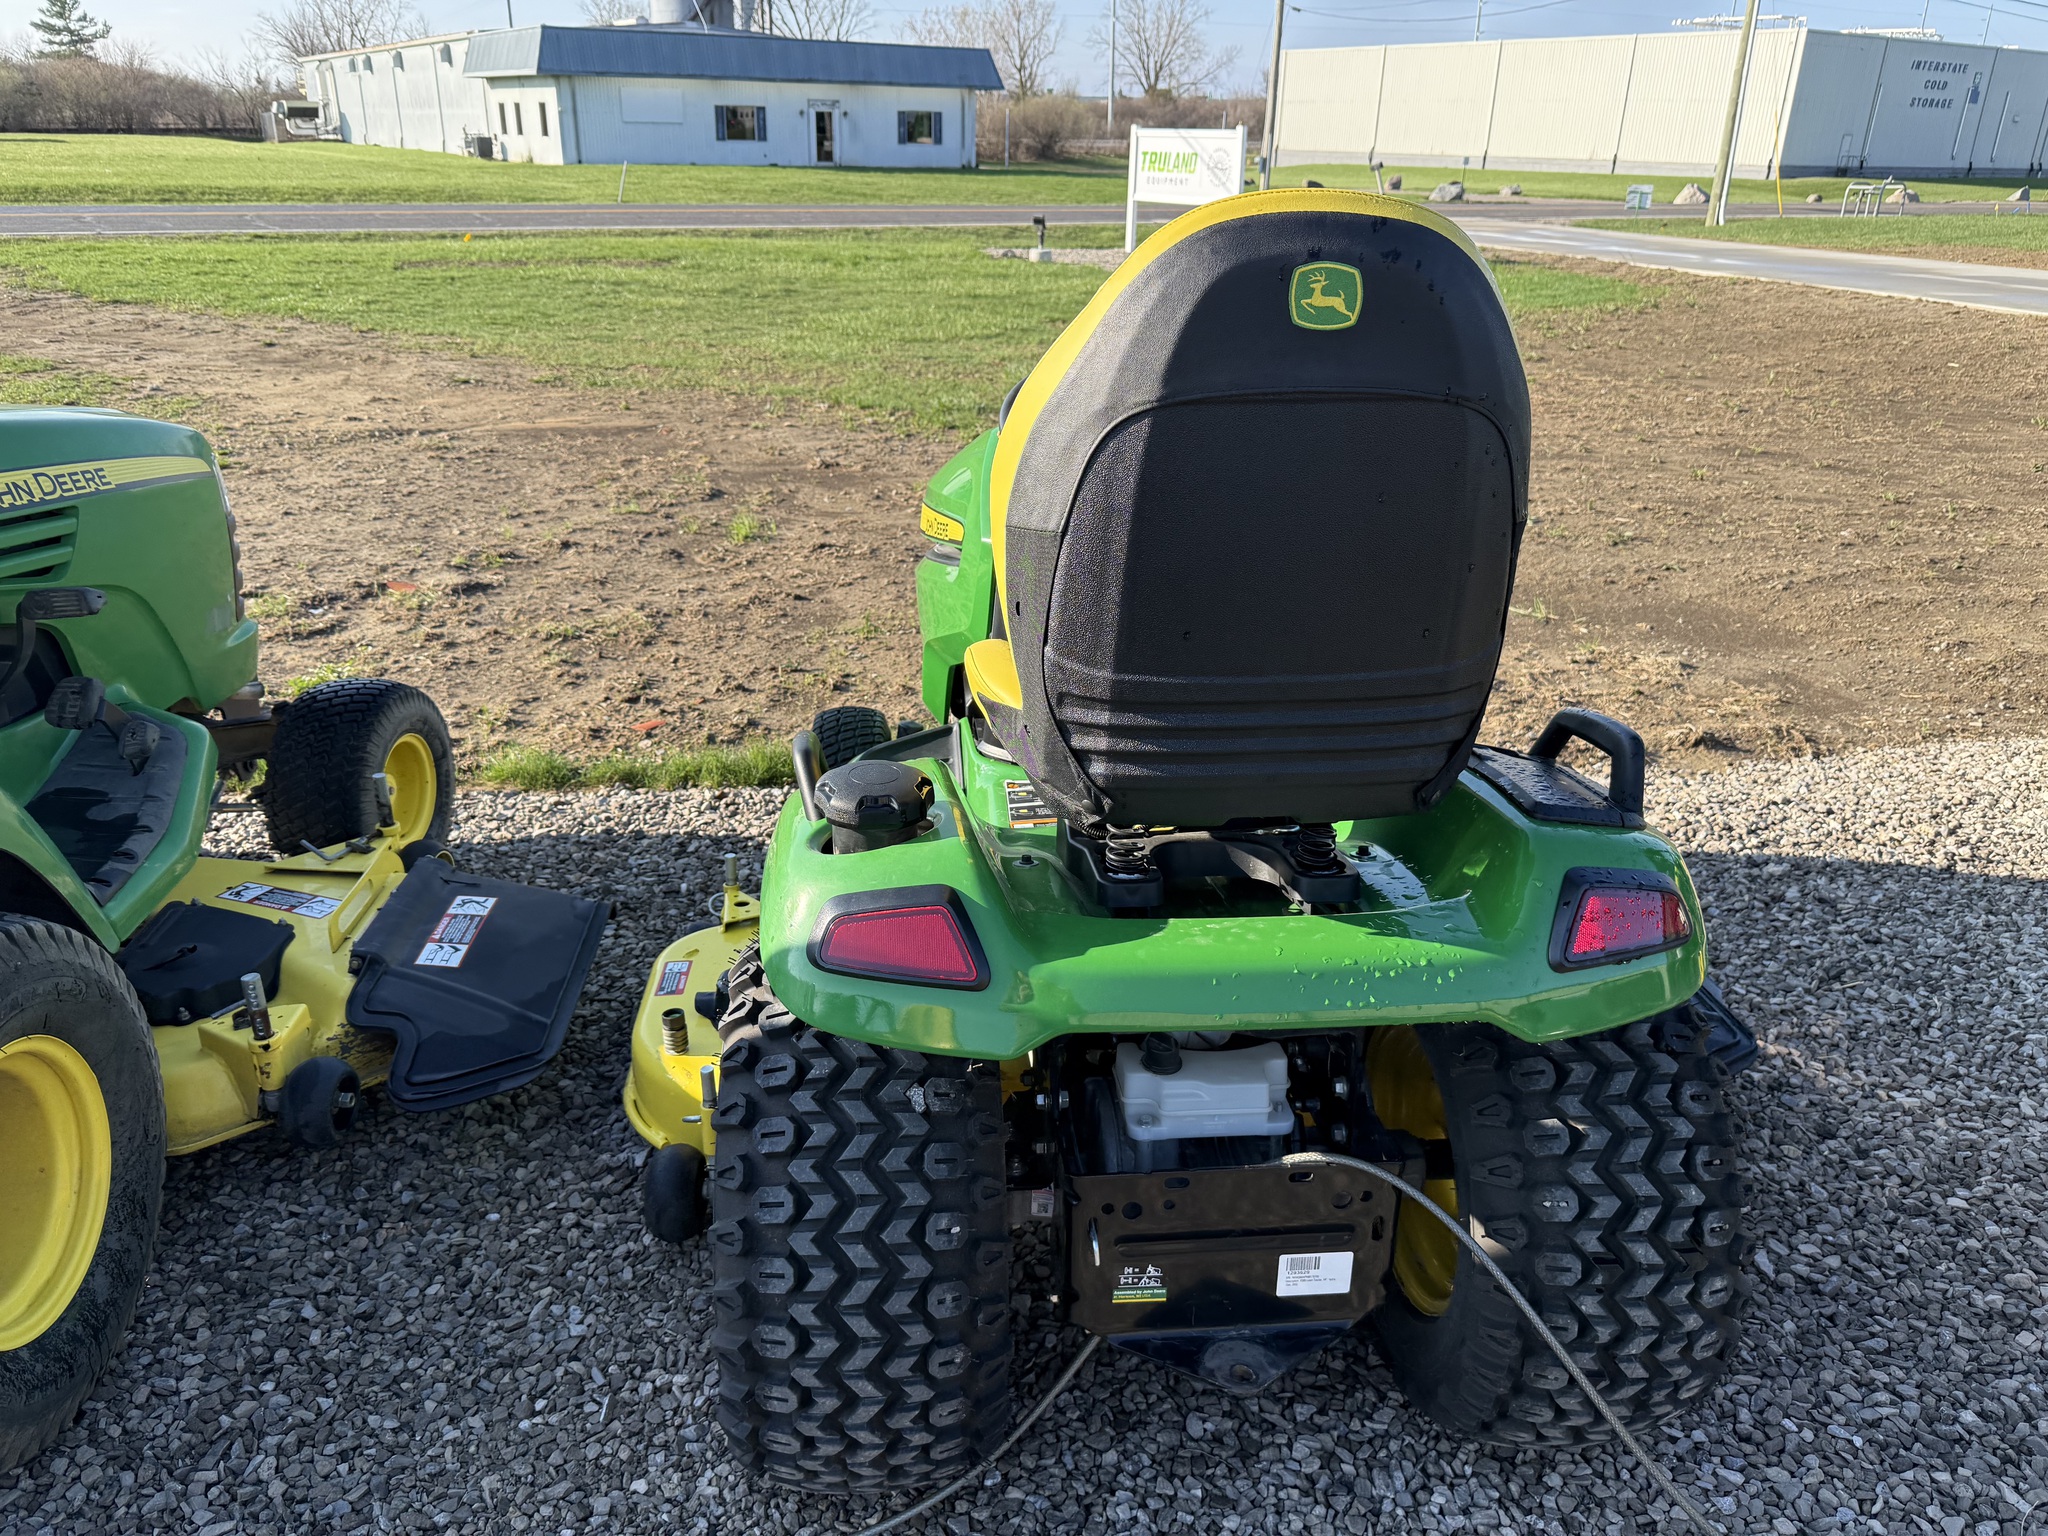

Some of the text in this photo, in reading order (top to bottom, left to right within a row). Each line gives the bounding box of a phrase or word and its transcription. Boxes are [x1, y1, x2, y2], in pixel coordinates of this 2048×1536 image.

[1911, 60, 1969, 74] INTERSTATE
[1924, 79, 1948, 90] COLD
[1910, 97, 1954, 108] STORAGE
[1141, 151, 1199, 174] TRULAND
[1146, 176, 1189, 186] EQUIPMENT
[32, 467, 113, 497] DEERE
